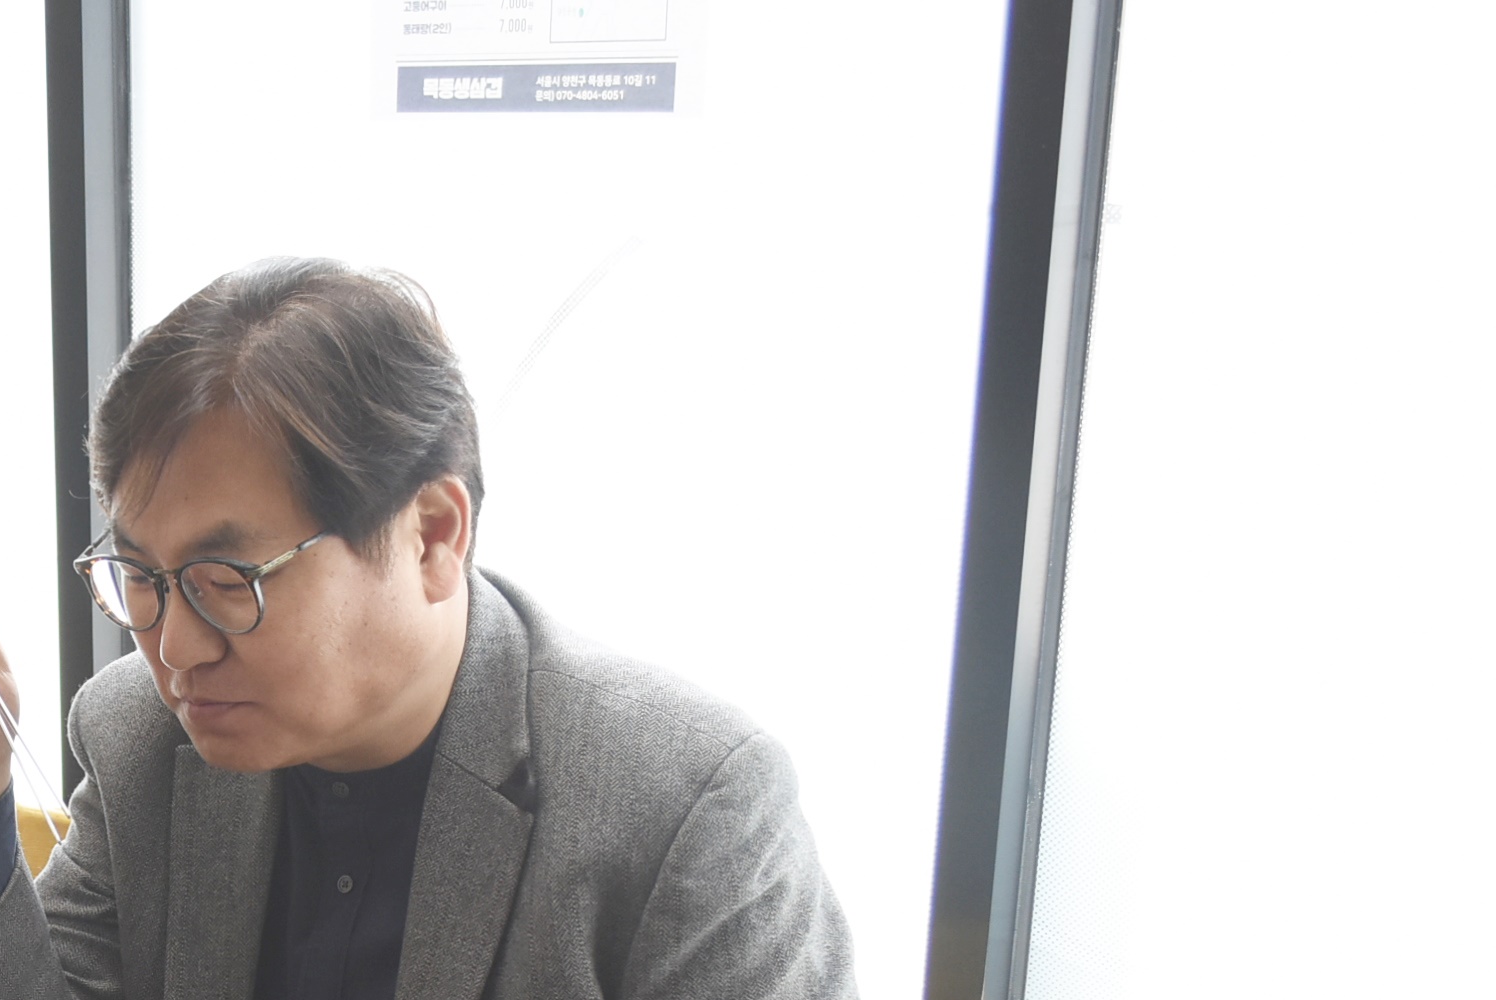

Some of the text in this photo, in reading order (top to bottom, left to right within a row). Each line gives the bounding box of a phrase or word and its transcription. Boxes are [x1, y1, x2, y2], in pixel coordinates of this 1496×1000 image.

[403, 0, 447, 12] 고등어구이
[535, 75, 560, 88] 서울시
[562, 75, 586, 87] 양천구
[623, 74, 643, 87] 10길
[645, 75, 656, 85] 11
[556, 89, 624, 101] 070-4804-6051
